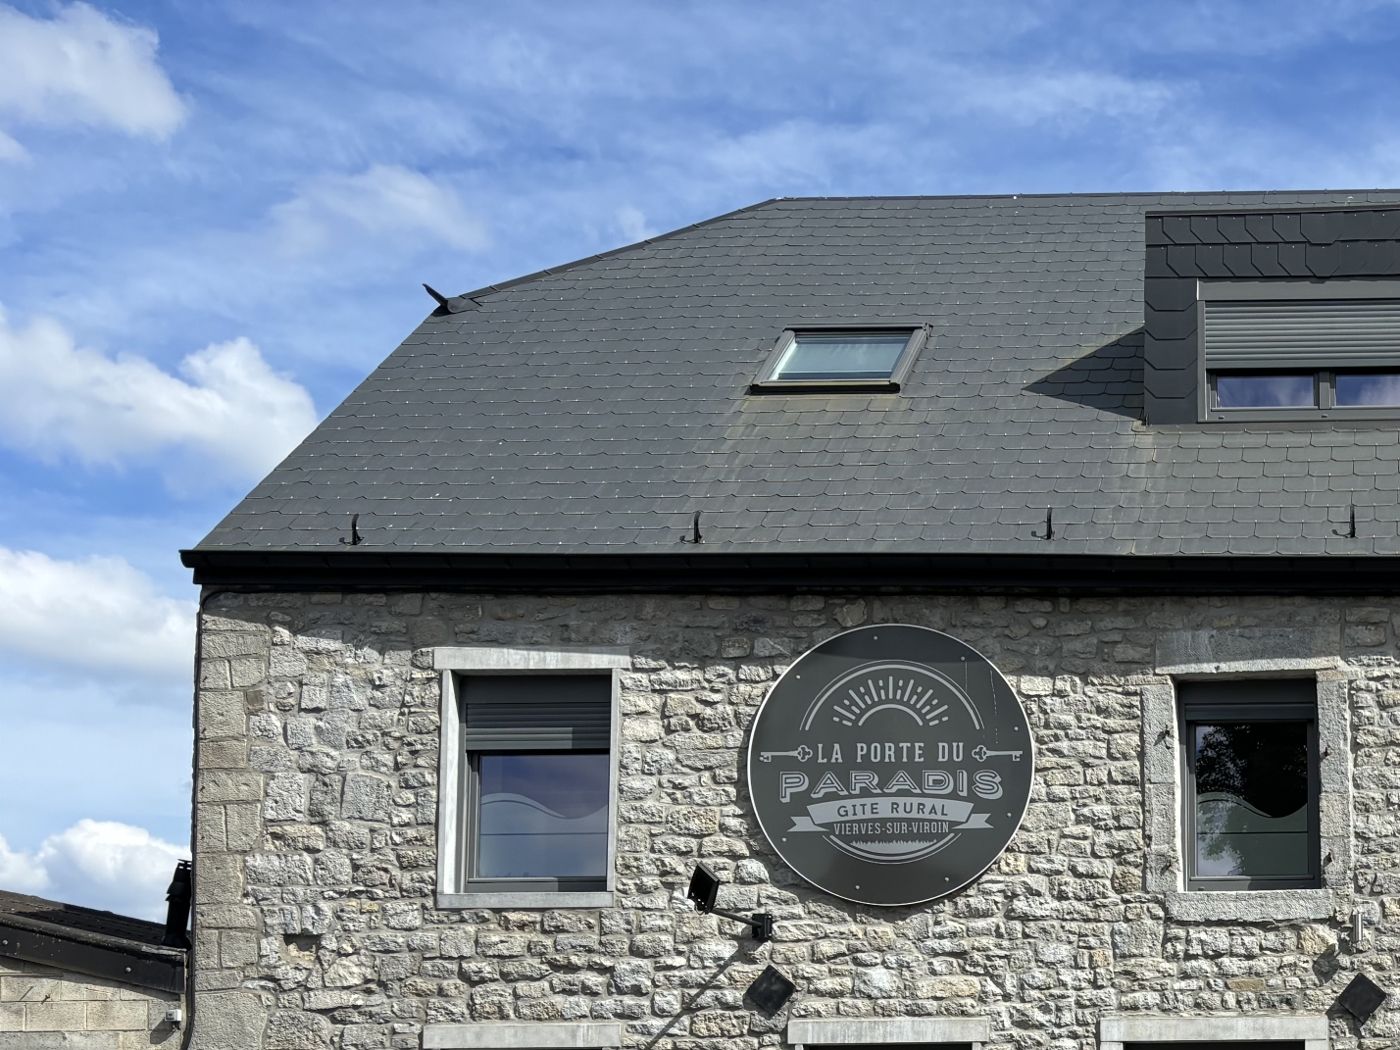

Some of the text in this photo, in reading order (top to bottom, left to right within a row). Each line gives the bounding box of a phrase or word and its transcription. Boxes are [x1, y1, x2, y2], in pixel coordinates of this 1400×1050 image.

[817, 742, 964, 763] LA PORTE DU
[779, 769, 1004, 803] PARADIS
[837, 802, 949, 817] GITE RURAL
[833, 821, 949, 835] VIERVES-SUR-VIROIN
